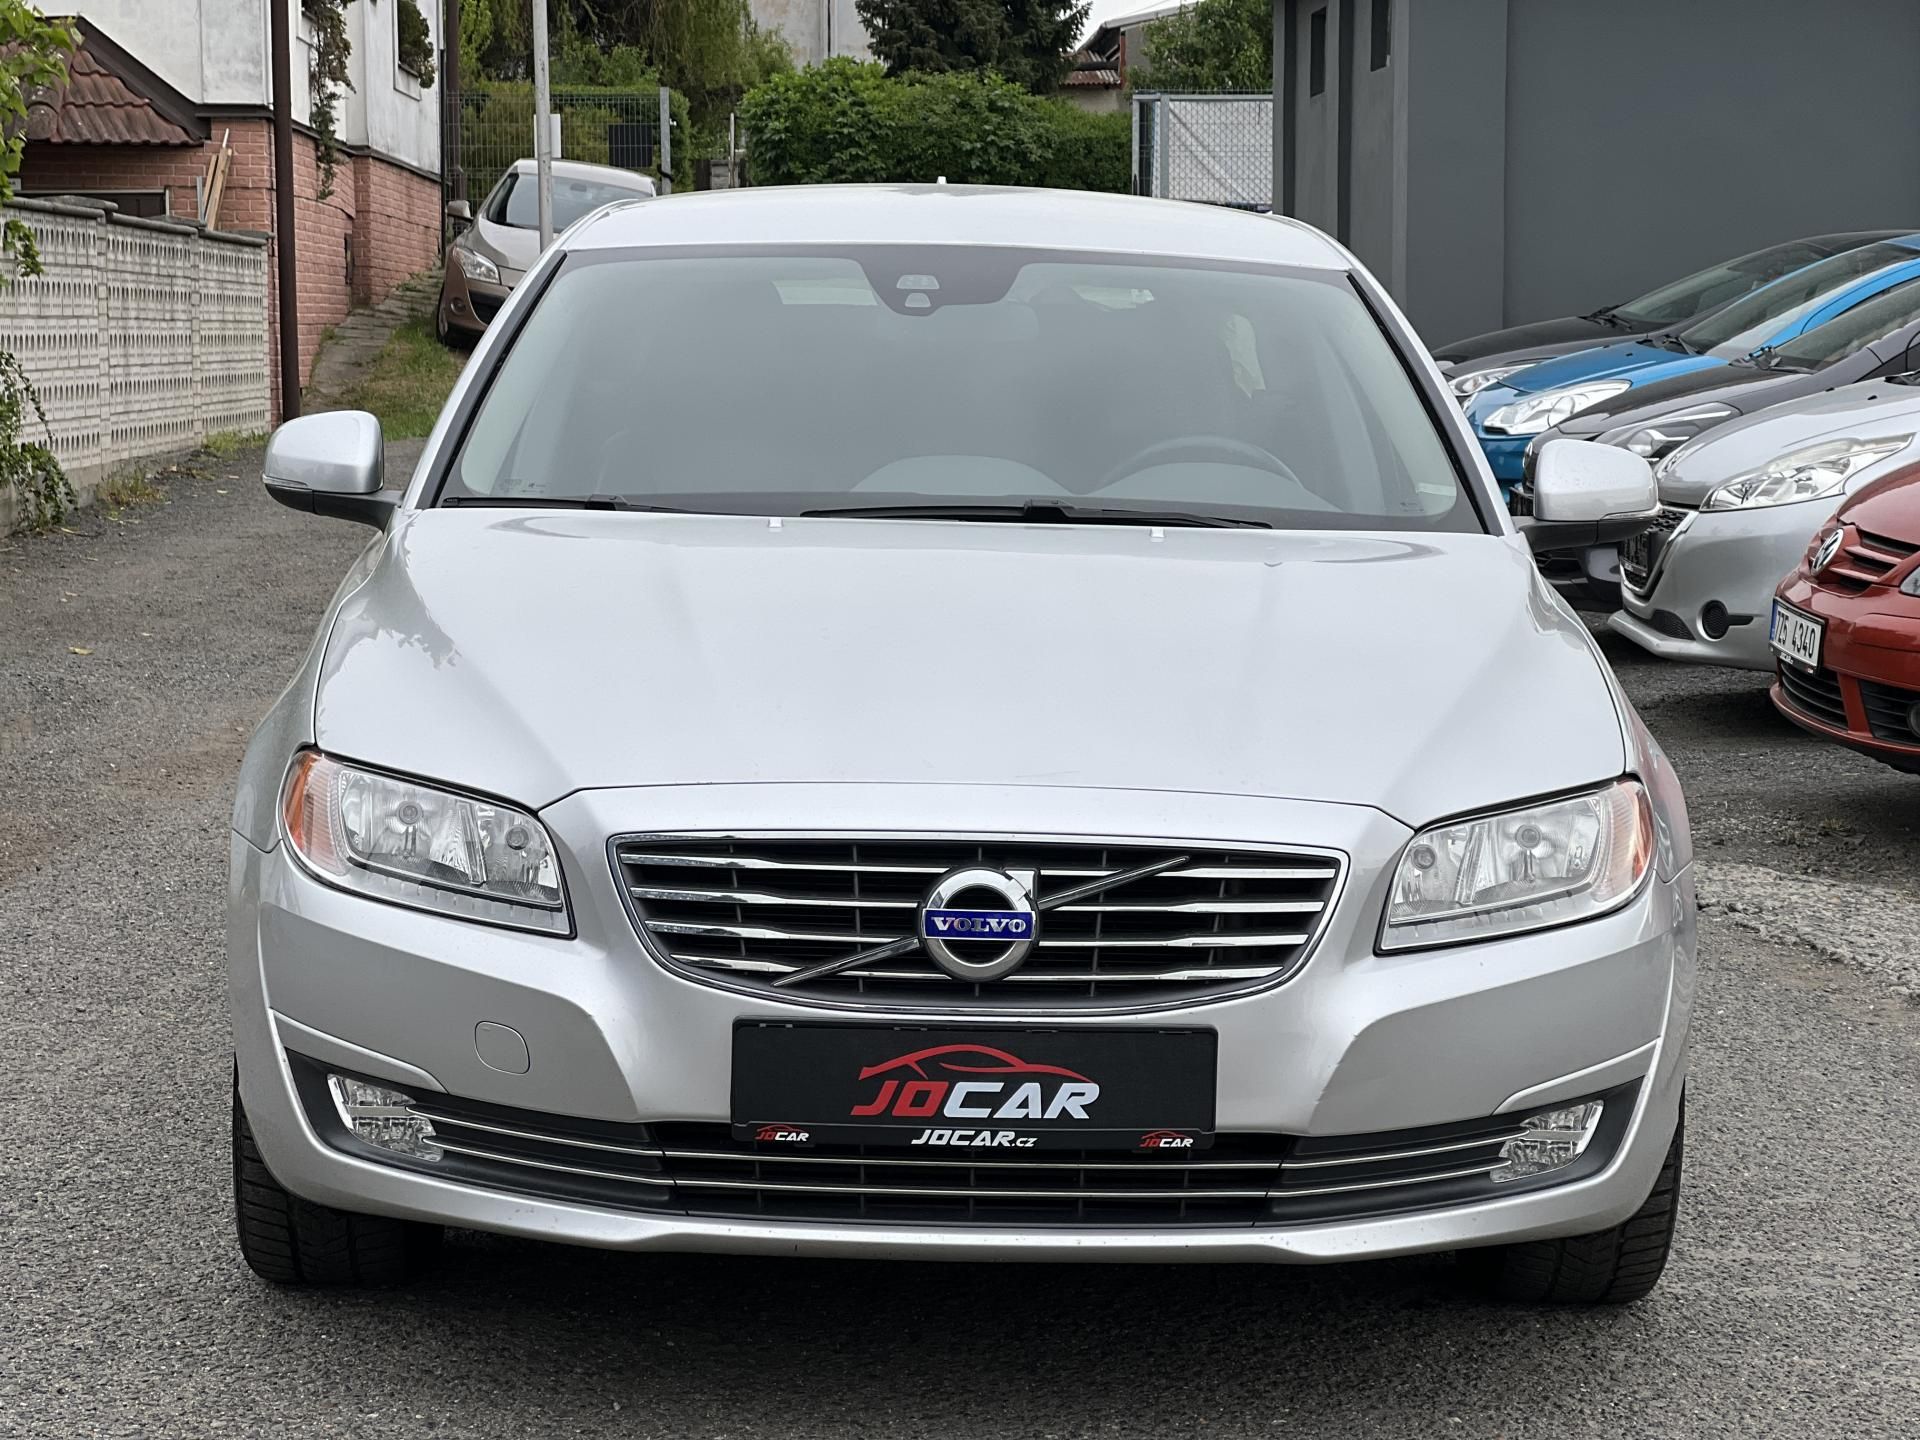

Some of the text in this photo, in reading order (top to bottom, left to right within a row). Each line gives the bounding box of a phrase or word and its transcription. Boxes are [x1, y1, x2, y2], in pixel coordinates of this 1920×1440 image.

[1792, 620, 1816, 659] 4340
[931, 917, 1026, 932] VOLVO
[850, 1080, 1100, 1119] JOCAR
[755, 1131, 809, 1142] JOCAR
[911, 1129, 1038, 1148] JOCAR.cz
[1139, 1138, 1194, 1148] JOCAR
